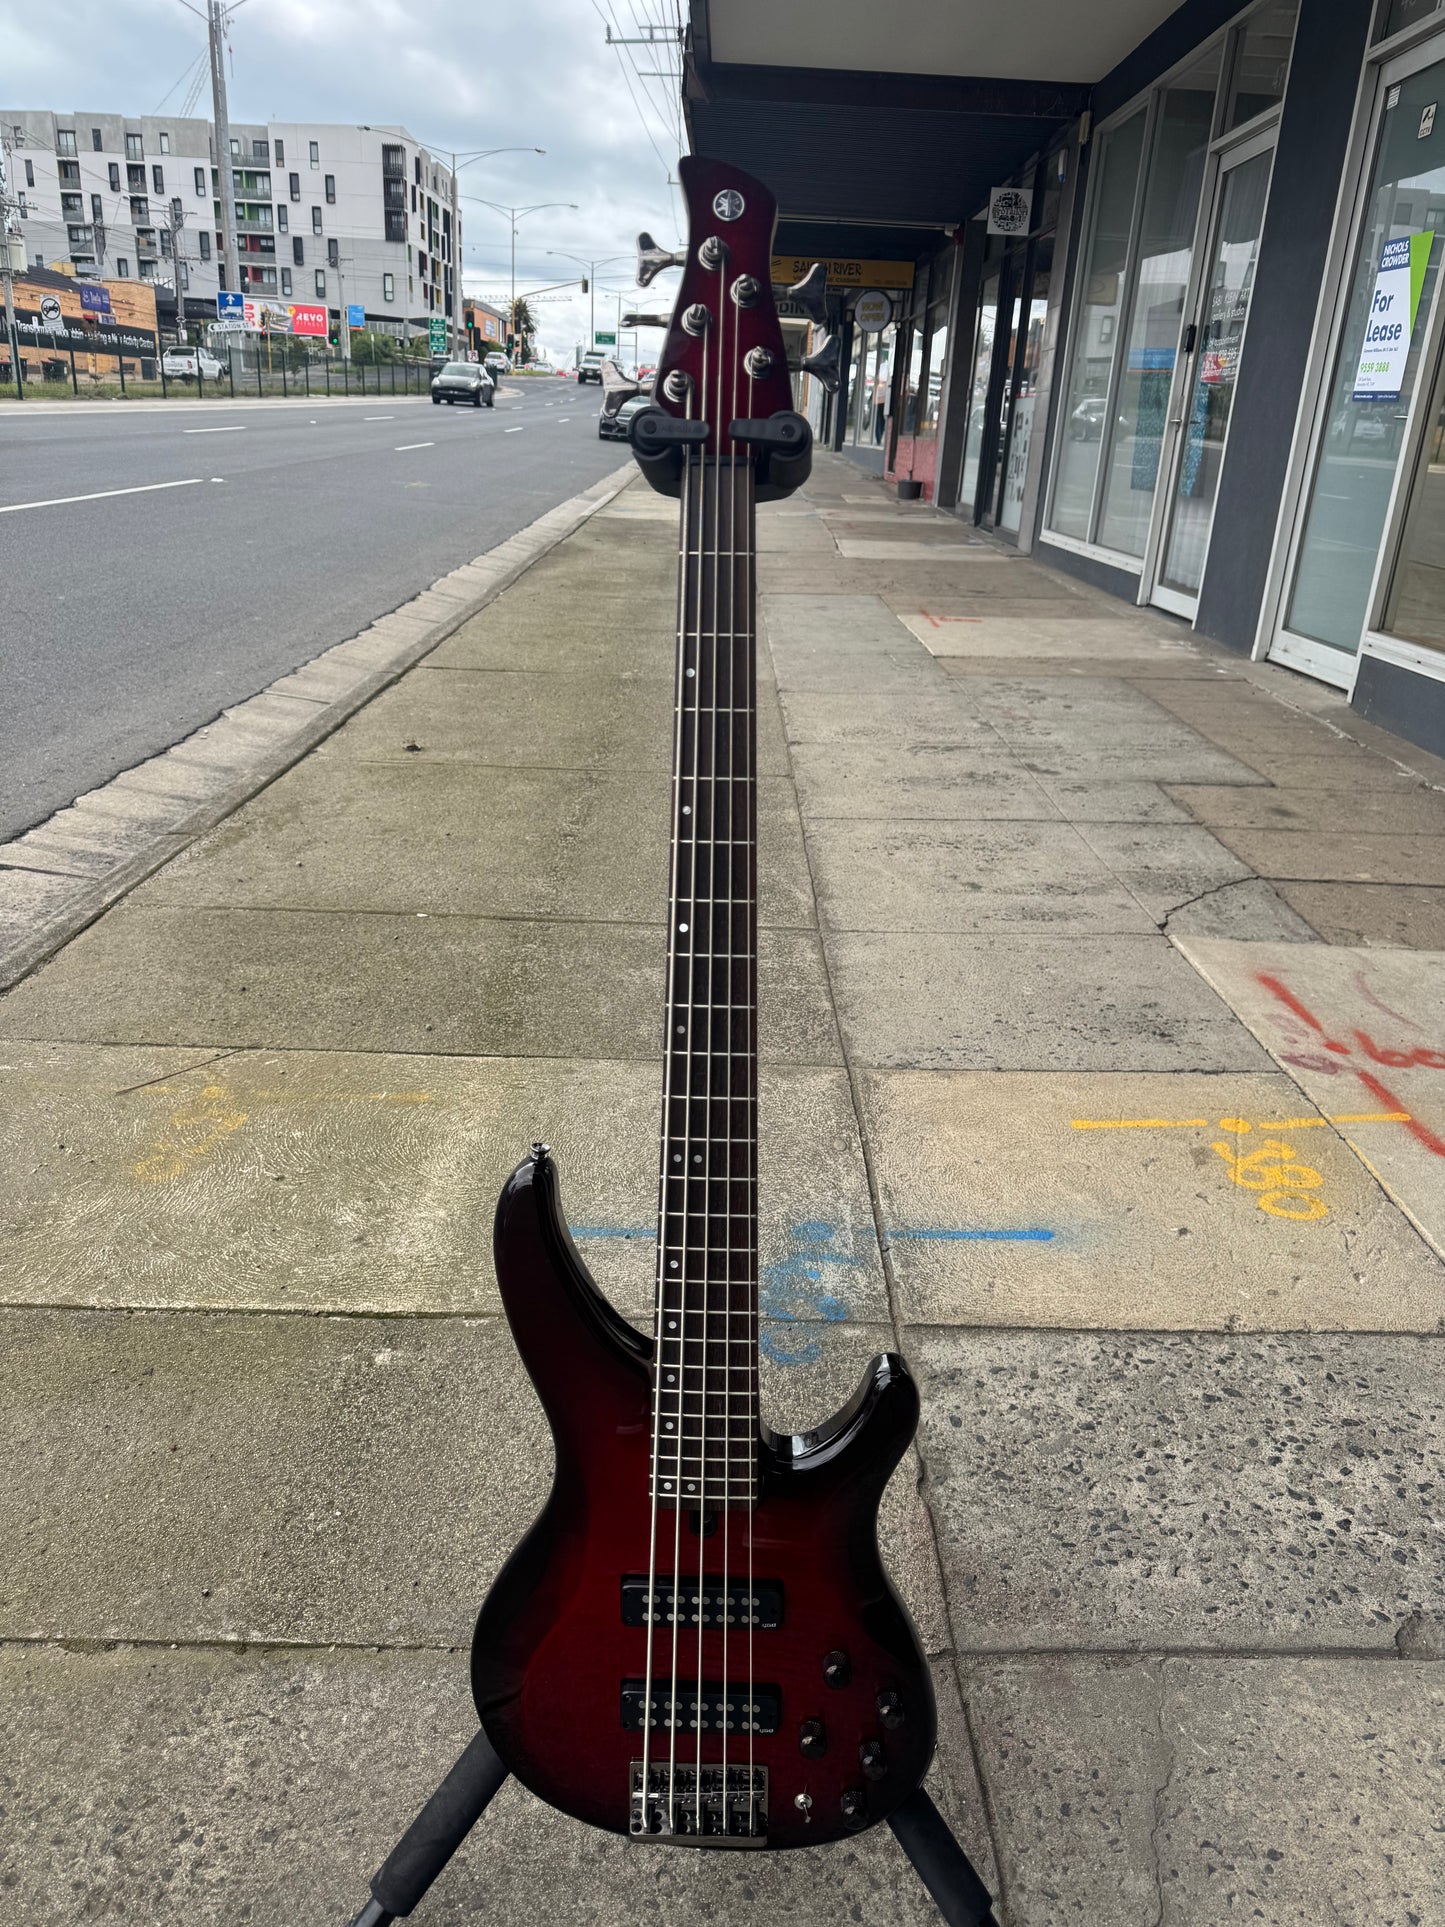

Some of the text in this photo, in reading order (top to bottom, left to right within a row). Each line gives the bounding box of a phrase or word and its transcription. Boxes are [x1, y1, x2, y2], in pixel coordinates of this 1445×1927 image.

[1419, 126, 1431, 136] CCTV
[1384, 240, 1409, 255] NICHOLS
[1381, 251, 1409, 267] CROWDER
[833, 261, 862, 276] RIVER
[1371, 289, 1394, 314] For
[296, 313, 324, 322] REVO
[1231, 304, 1245, 318] studio
[1366, 320, 1402, 343] Lease
[1360, 361, 1374, 374] 9559
